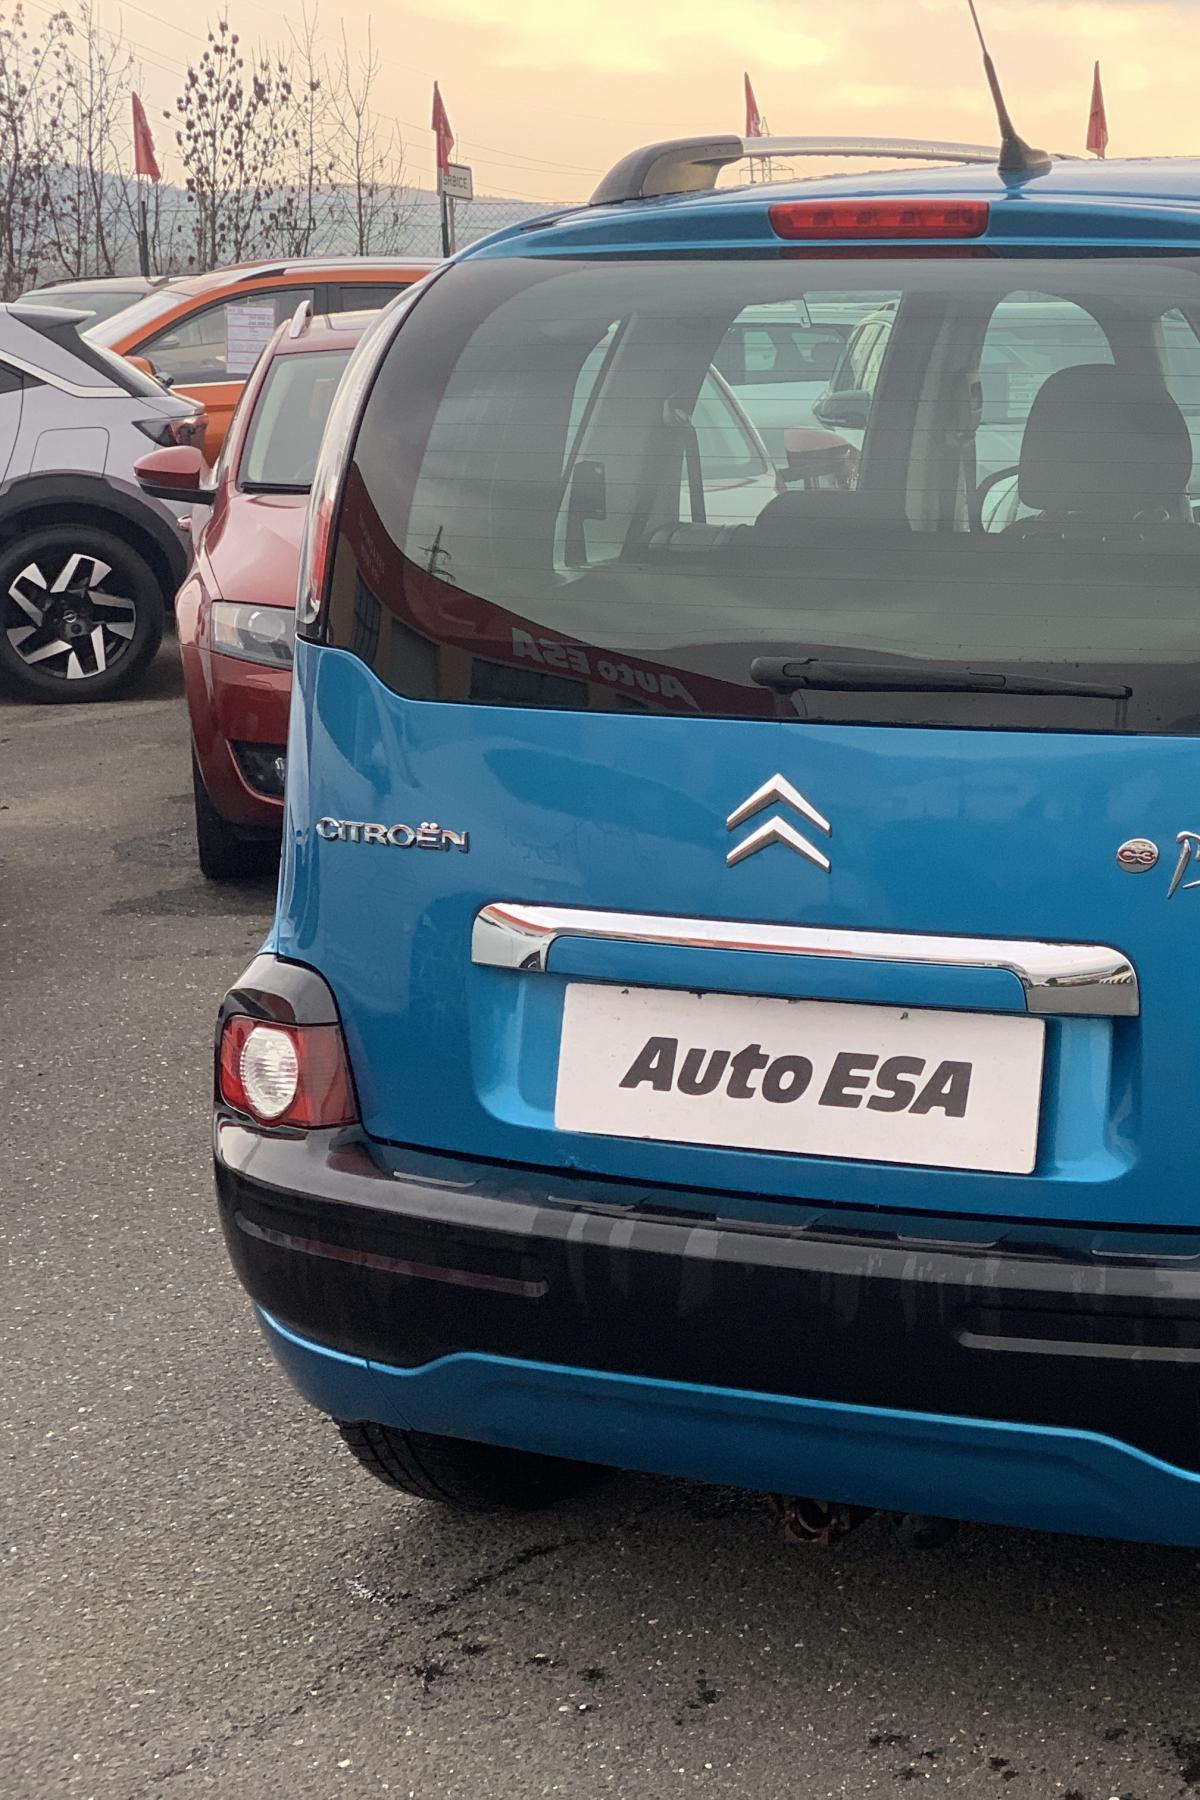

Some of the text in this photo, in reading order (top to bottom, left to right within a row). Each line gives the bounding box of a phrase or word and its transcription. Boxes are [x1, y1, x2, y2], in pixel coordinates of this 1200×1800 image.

[316, 816, 470, 854] CITROËN
[618, 1036, 973, 1118] Auto ESA
